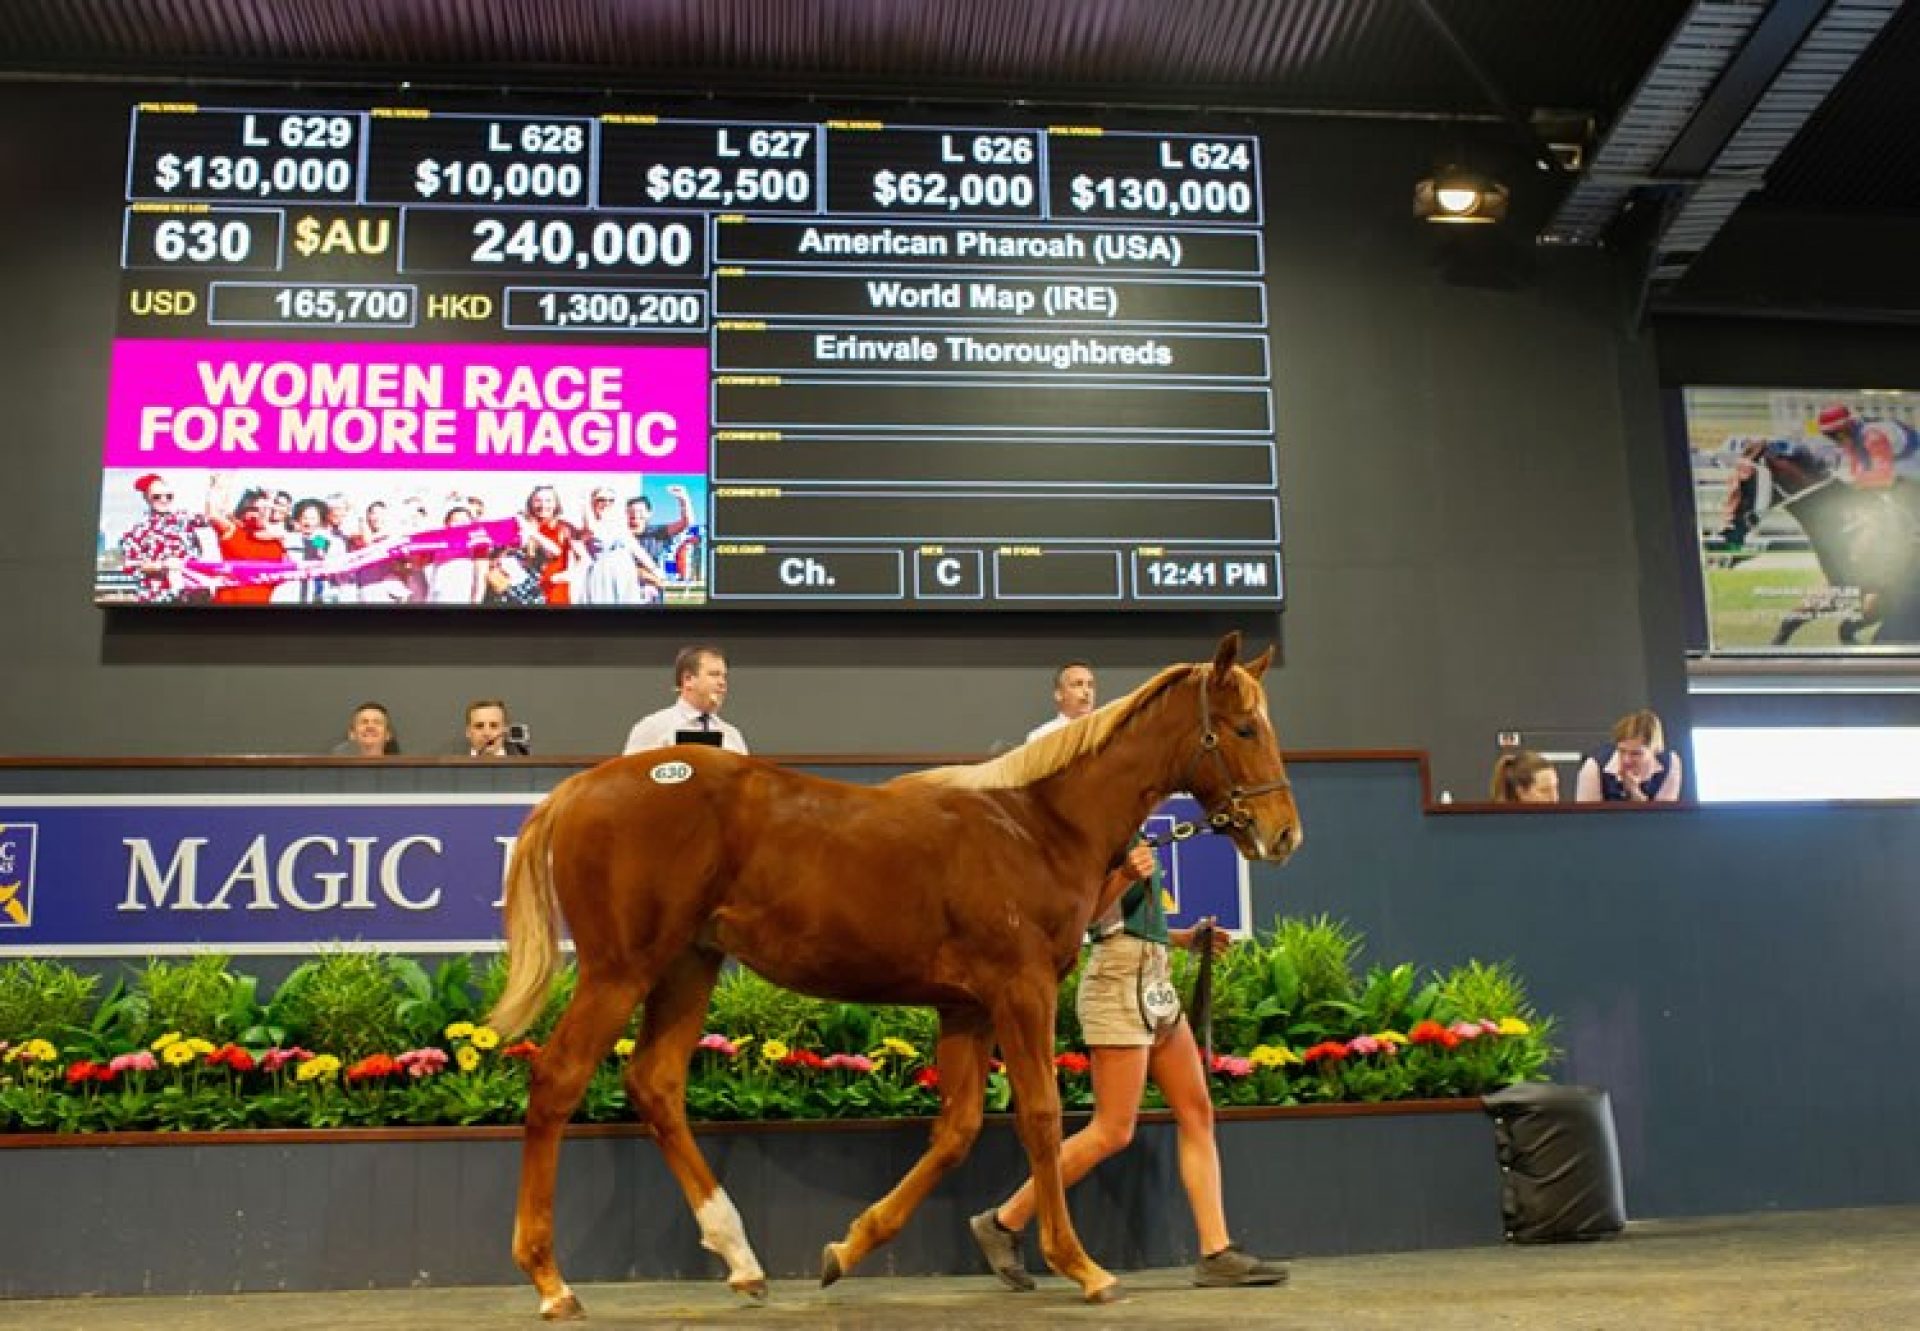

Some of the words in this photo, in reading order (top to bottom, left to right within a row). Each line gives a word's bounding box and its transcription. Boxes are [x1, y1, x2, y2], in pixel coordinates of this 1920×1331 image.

[242, 114, 269, 147] L
[280, 115, 352, 149] 629
[488, 122, 513, 152] L
[521, 124, 584, 154] 628
[718, 129, 741, 157] L
[749, 130, 810, 159] 627
[941, 135, 966, 162] L
[972, 135, 1033, 165] 626
[1161, 140, 1184, 168] L
[1191, 142, 1250, 171] 624
[155, 153, 350, 196] $130,000
[414, 158, 582, 201] $10,000
[646, 163, 810, 206] $62,500
[872, 170, 1033, 210] $62,000
[1071, 175, 1251, 215] $130,000
[154, 219, 251, 263] 630
[294, 216, 390, 257] $AU
[471, 219, 692, 270] 240,000
[798, 227, 948, 255] American
[956, 231, 1085, 258] Pharoah
[1093, 233, 1182, 265] (USA)
[130, 290, 196, 316] USD
[275, 289, 408, 322] 165,700
[427, 294, 492, 319] HKD
[538, 291, 700, 325] 1,300,200
[867, 281, 961, 309] World
[970, 282, 1035, 313] Map
[1043, 284, 1118, 316] (IRE)
[816, 335, 938, 362] Erinvale
[945, 336, 1173, 369] Thoroughbreds
[197, 361, 443, 407] WOMEN
[464, 365, 623, 410] RACE
[140, 406, 260, 452] FOR
[279, 408, 456, 454] MORE
[476, 411, 678, 457] MAGIC
[780, 557, 836, 585] Ch.
[936, 559, 961, 586] C
[1148, 562, 1217, 586] 12:41
[1225, 562, 1268, 587] PM
[654, 766, 687, 779] 630
[117, 834, 442, 911] MAGIC
